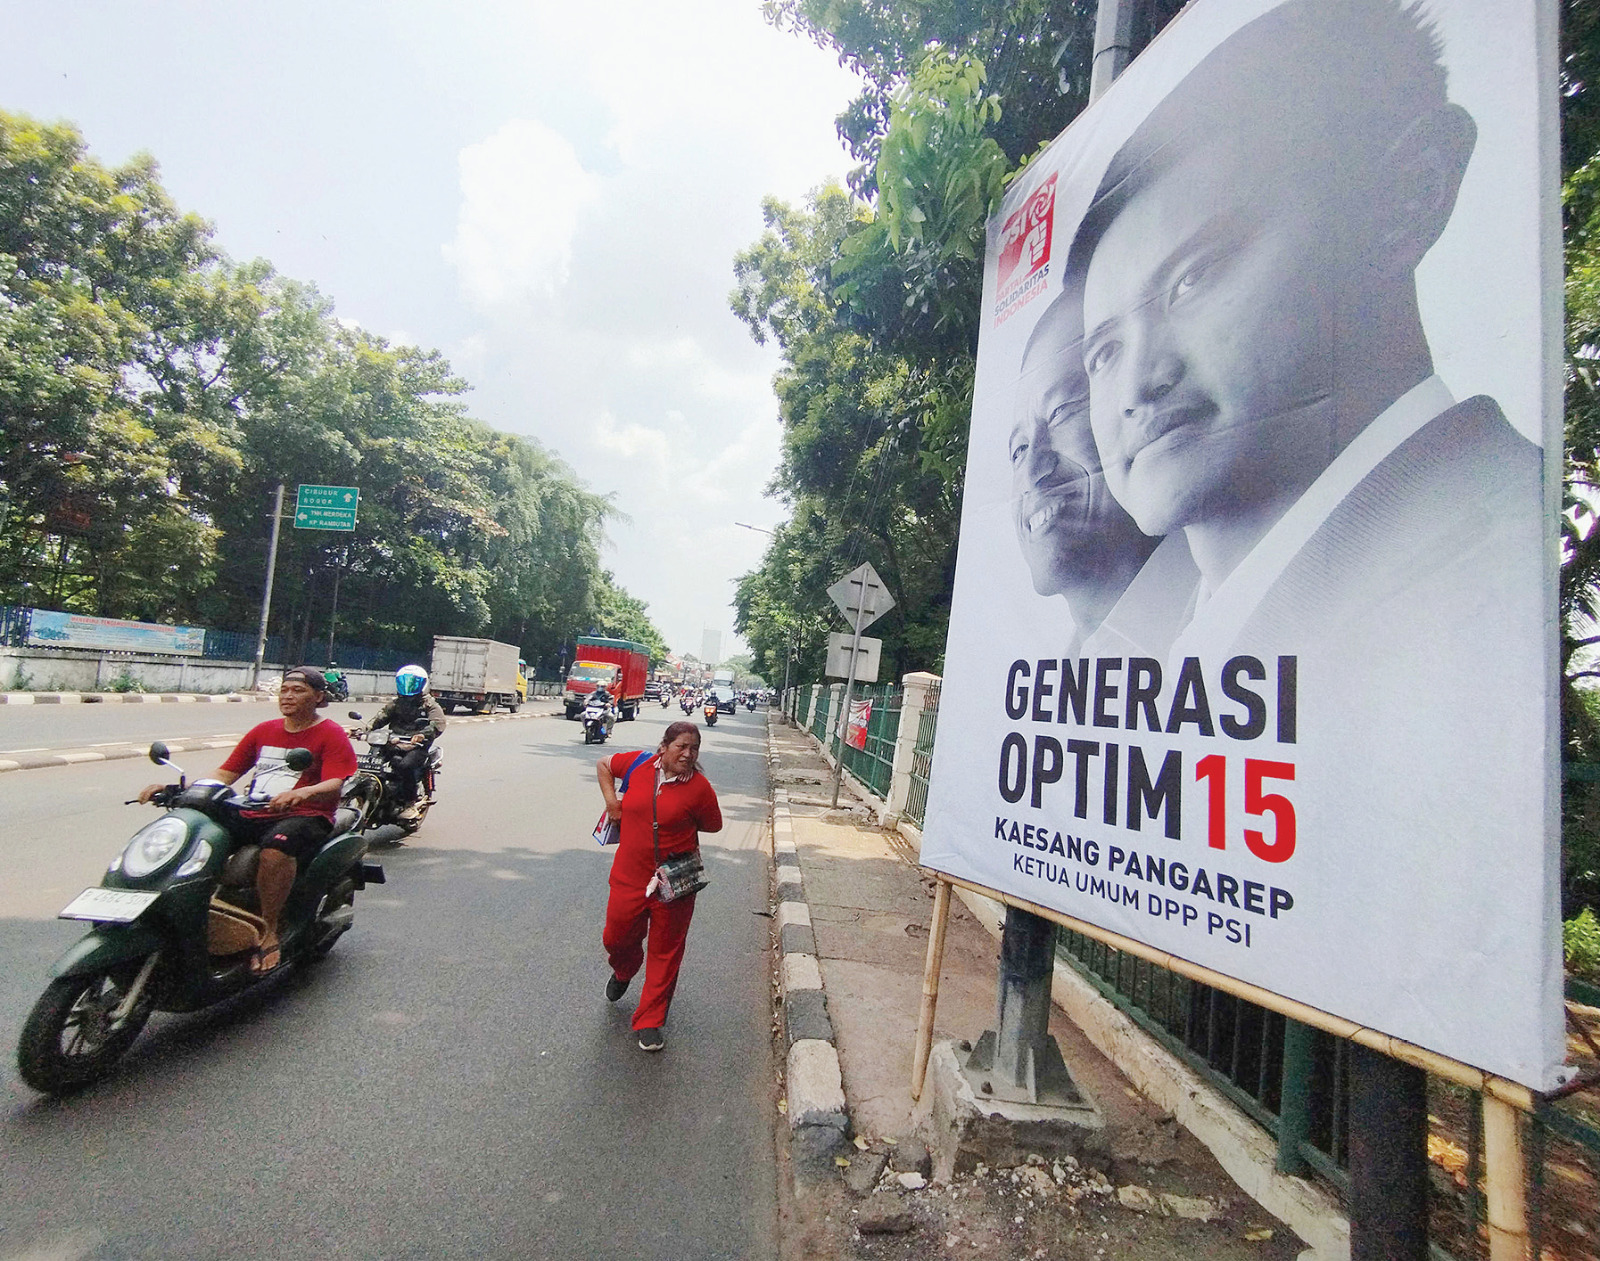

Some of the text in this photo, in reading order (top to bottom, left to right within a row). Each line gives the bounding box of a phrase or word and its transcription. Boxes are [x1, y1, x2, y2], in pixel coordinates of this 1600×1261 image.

[993, 279, 1048, 328] INDONESIA
[995, 263, 1049, 316] SOLIDARITAS
[996, 276, 1023, 304] PARTAI
[1005, 655, 1297, 744] GENERASI
[999, 732, 1296, 863] OPTIM15
[994, 817, 1294, 919] KAESANG PANGAREP
[1013, 853, 1251, 948] KETUA UMUM DPP PSI
